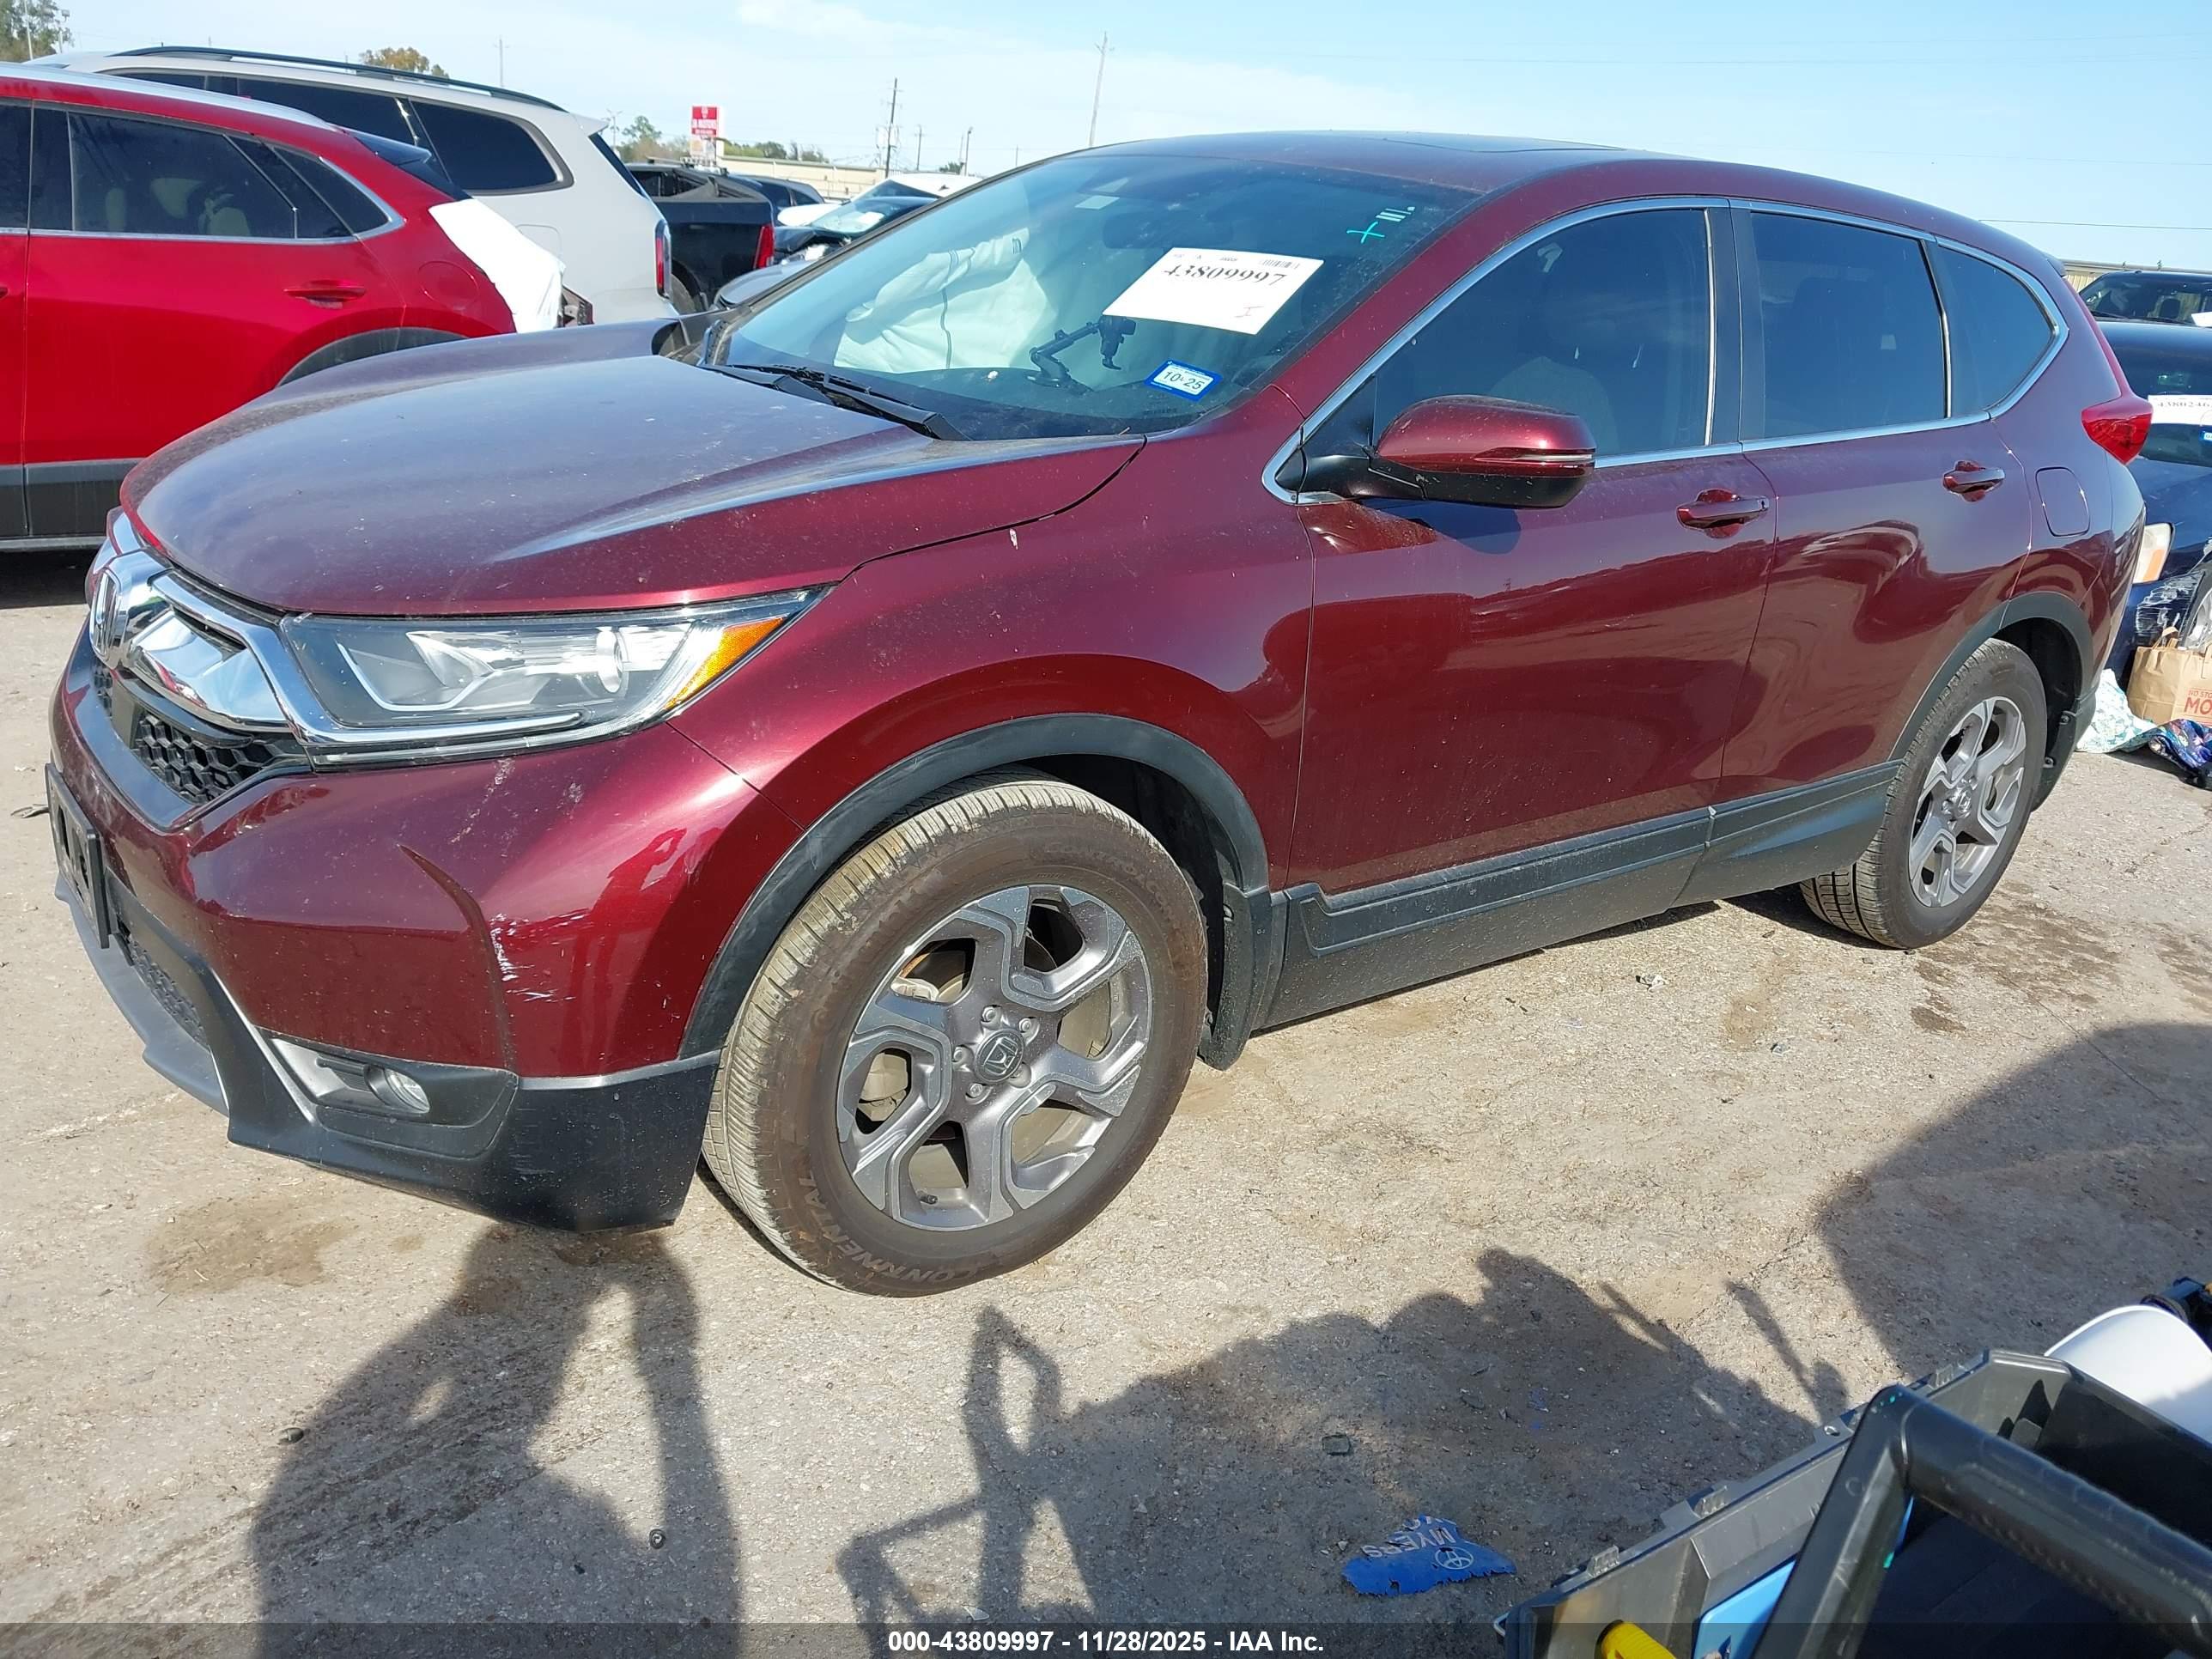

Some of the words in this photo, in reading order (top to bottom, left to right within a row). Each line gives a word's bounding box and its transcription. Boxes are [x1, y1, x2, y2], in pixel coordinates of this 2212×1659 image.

[1164, 264, 1287, 285] 43809997
[1164, 371, 1181, 382] 10
[1183, 378, 1206, 391] 25
[1361, 1527, 1457, 1559] MYERS
